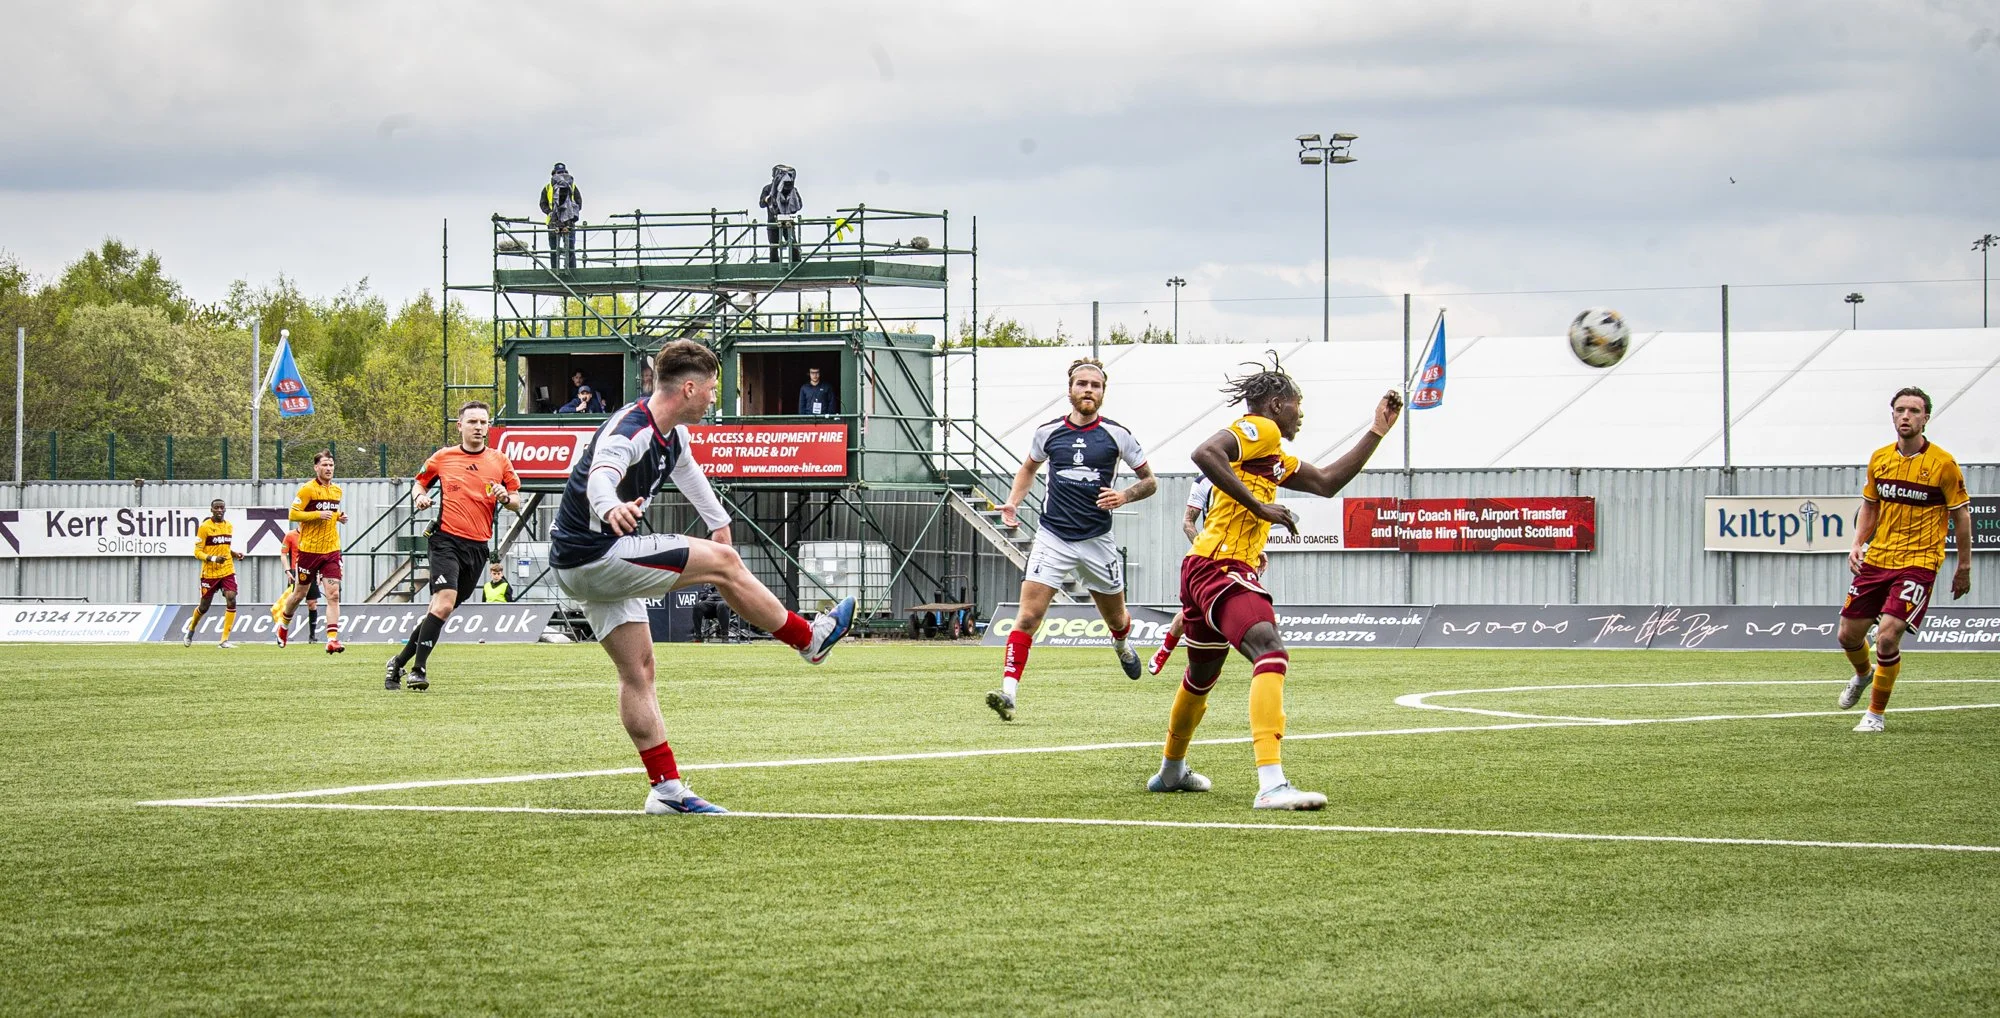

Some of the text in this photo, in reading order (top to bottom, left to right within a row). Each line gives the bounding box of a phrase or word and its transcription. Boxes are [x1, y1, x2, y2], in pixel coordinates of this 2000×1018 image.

[706, 432, 744, 444] ACCESS
[745, 432, 755, 444] &
[756, 432, 818, 444] EQUIPMENT
[818, 431, 843, 443] HIRE
[505, 441, 570, 462] Moore
[712, 446, 800, 458] FOR TRADE & DIY
[715, 463, 734, 473] 000
[742, 463, 843, 473] www.moore-hire.com
[1897, 487, 1928, 501] CLAIMS
[1377, 507, 1568, 524] Luxury Coach Hire, Airport Transfer
[1967, 505, 1997, 514] ORIES
[46, 508, 211, 538] Kerr Stirlin
[1266, 535, 1339, 544] MIDLAND COACHES
[1371, 525, 1574, 541] and Private Hire Throughout Scotland
[97, 537, 167, 554] Solicitors
[1849, 585, 1859, 595] CL
[1899, 580, 1925, 606] 20
[644, 597, 662, 607] AR
[677, 593, 696, 606] VAR
[15, 611, 142, 623] 01324 712677
[181, 609, 538, 638] cruncycarrotco.uk
[1924, 615, 2000, 628] Take care
[6, 628, 131, 637] cams-construction.com
[1278, 631, 1377, 642] 324 622776
